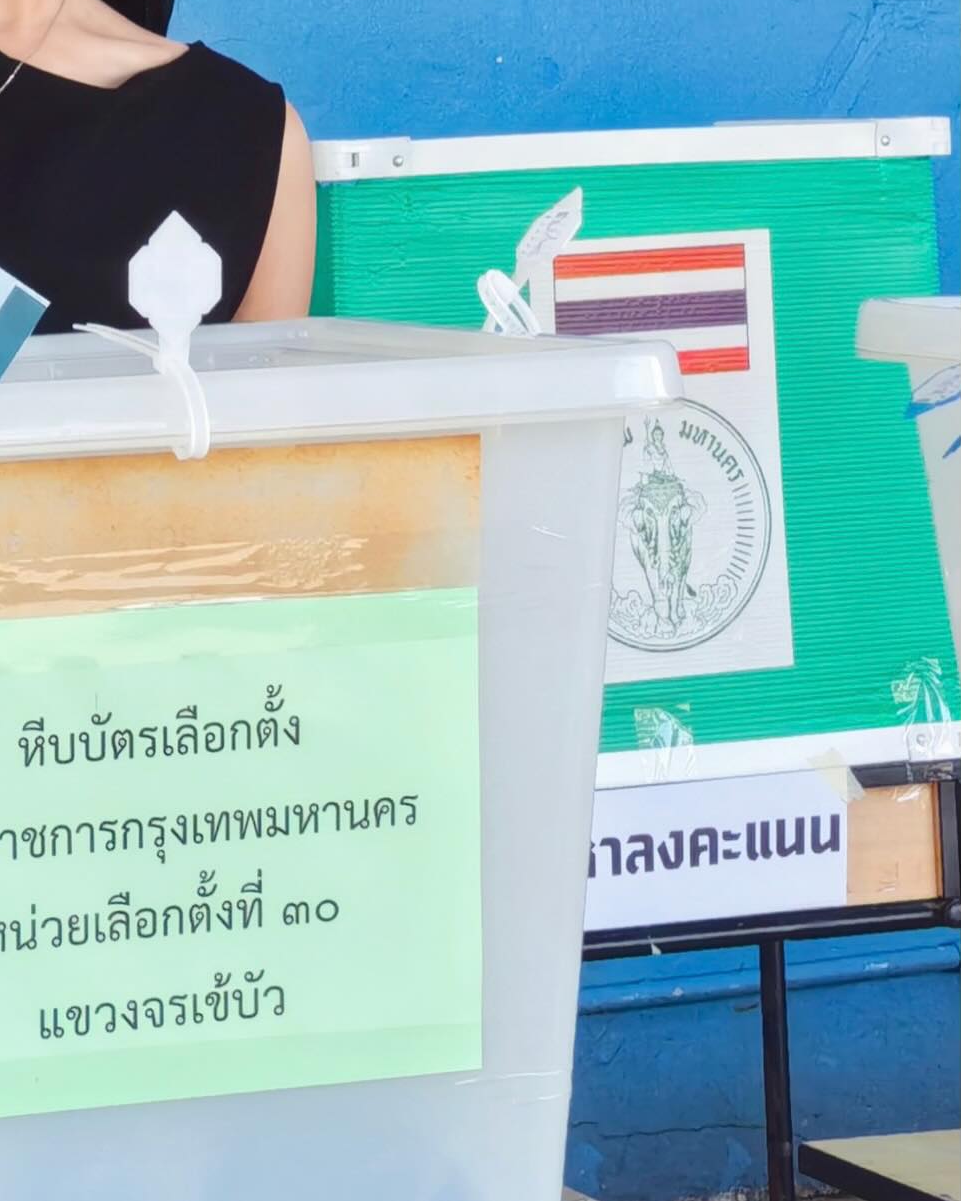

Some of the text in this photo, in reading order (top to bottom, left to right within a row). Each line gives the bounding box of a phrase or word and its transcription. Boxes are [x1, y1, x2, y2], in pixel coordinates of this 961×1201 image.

[18, 685, 299, 767] หีบบัตรเลือกตั้ง
[588, 815, 839, 877] าลงคะแนน
[283, 900, 339, 925] ๓๐
[41, 970, 284, 1039] แขวงจรเข้บัว
